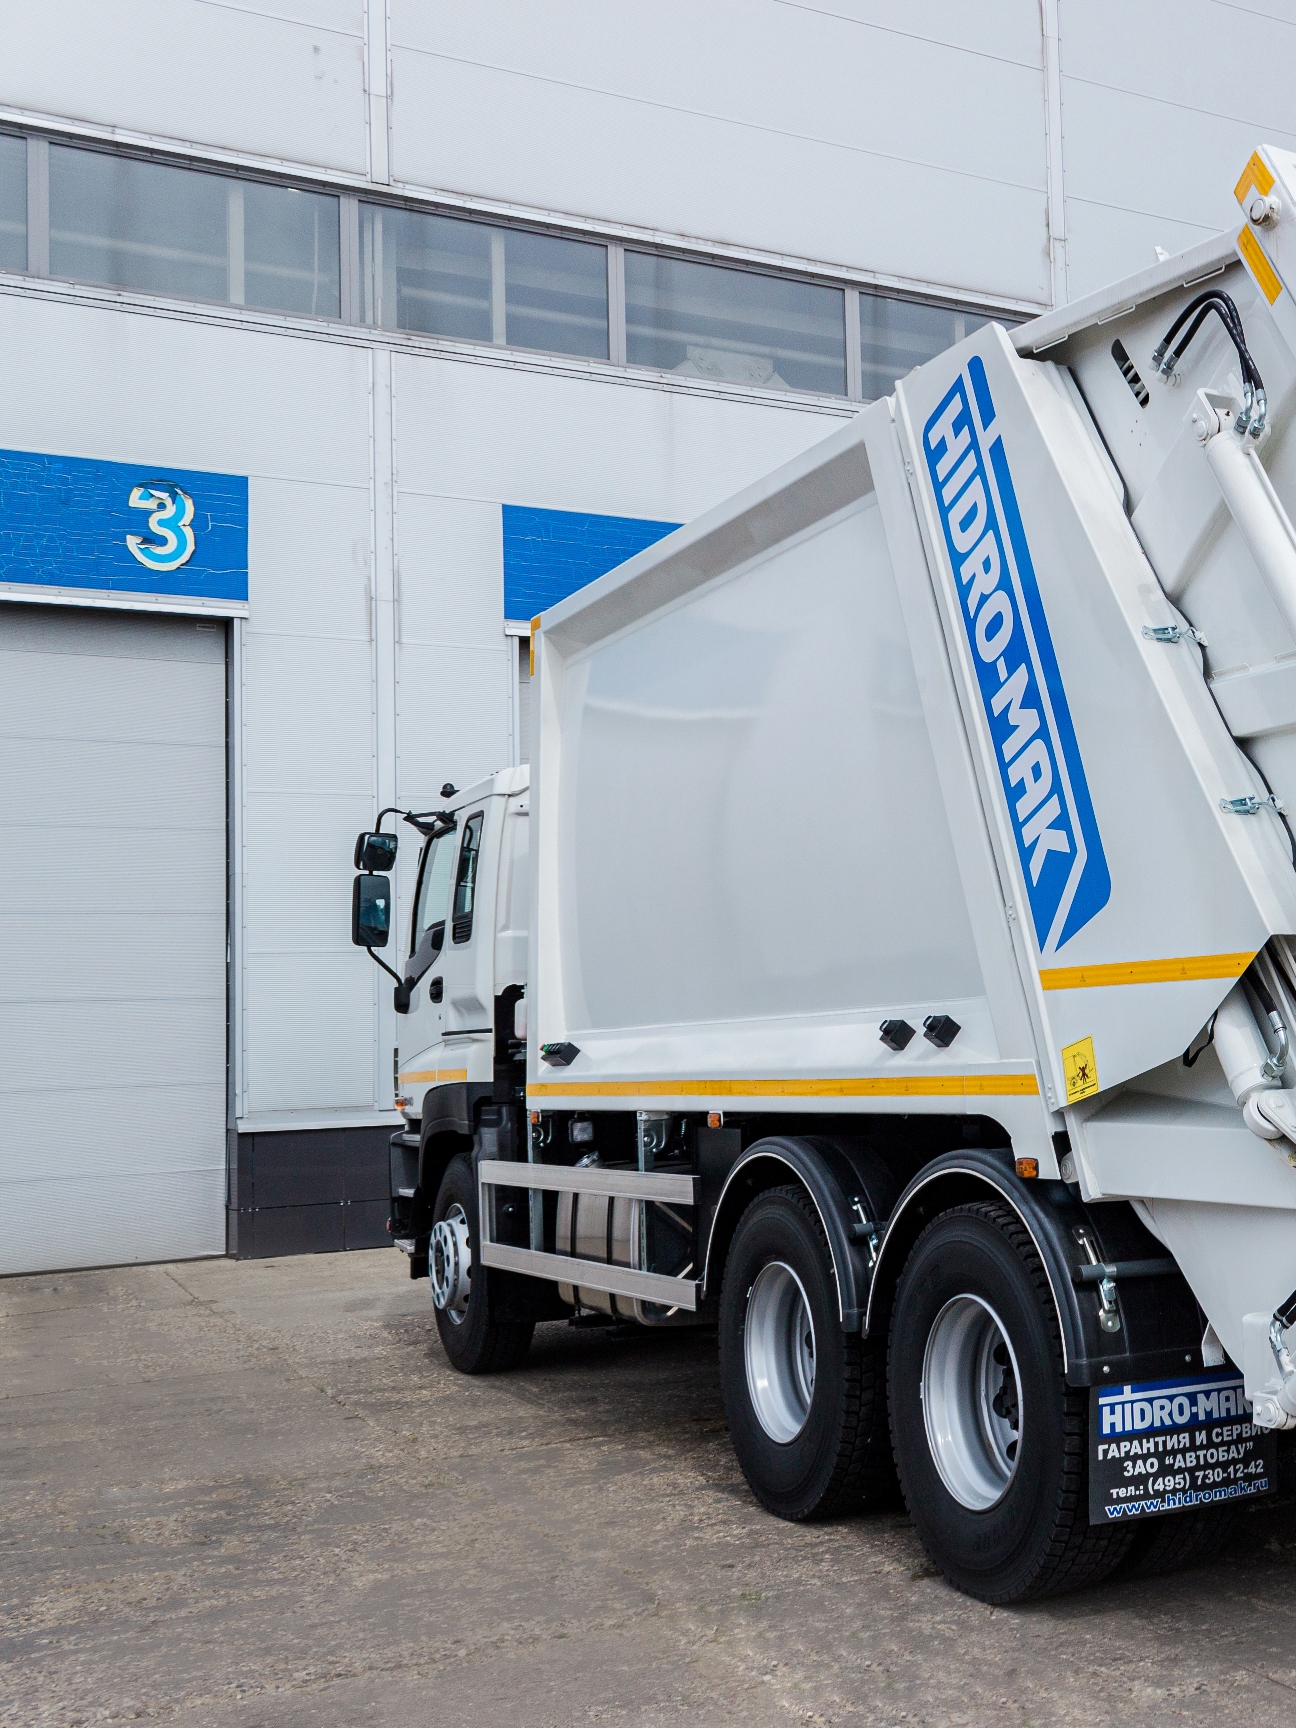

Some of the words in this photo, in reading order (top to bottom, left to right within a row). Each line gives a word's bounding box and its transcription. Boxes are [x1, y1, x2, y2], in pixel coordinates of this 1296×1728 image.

[126, 479, 195, 571] 3
[930, 391, 1070, 888] HIDRO-MAK
[1098, 1432, 1190, 1461] ГАРАНТИЯ
[1195, 1430, 1207, 1446] И
[1110, 1485, 1144, 1499] тел.:
[1148, 1474, 1190, 1495] (495)
[1195, 1459, 1264, 1486] 730-12-42
[1123, 1458, 1159, 1477] ЗАО
[1105, 1477, 1269, 1518] www.hidromak.ru
